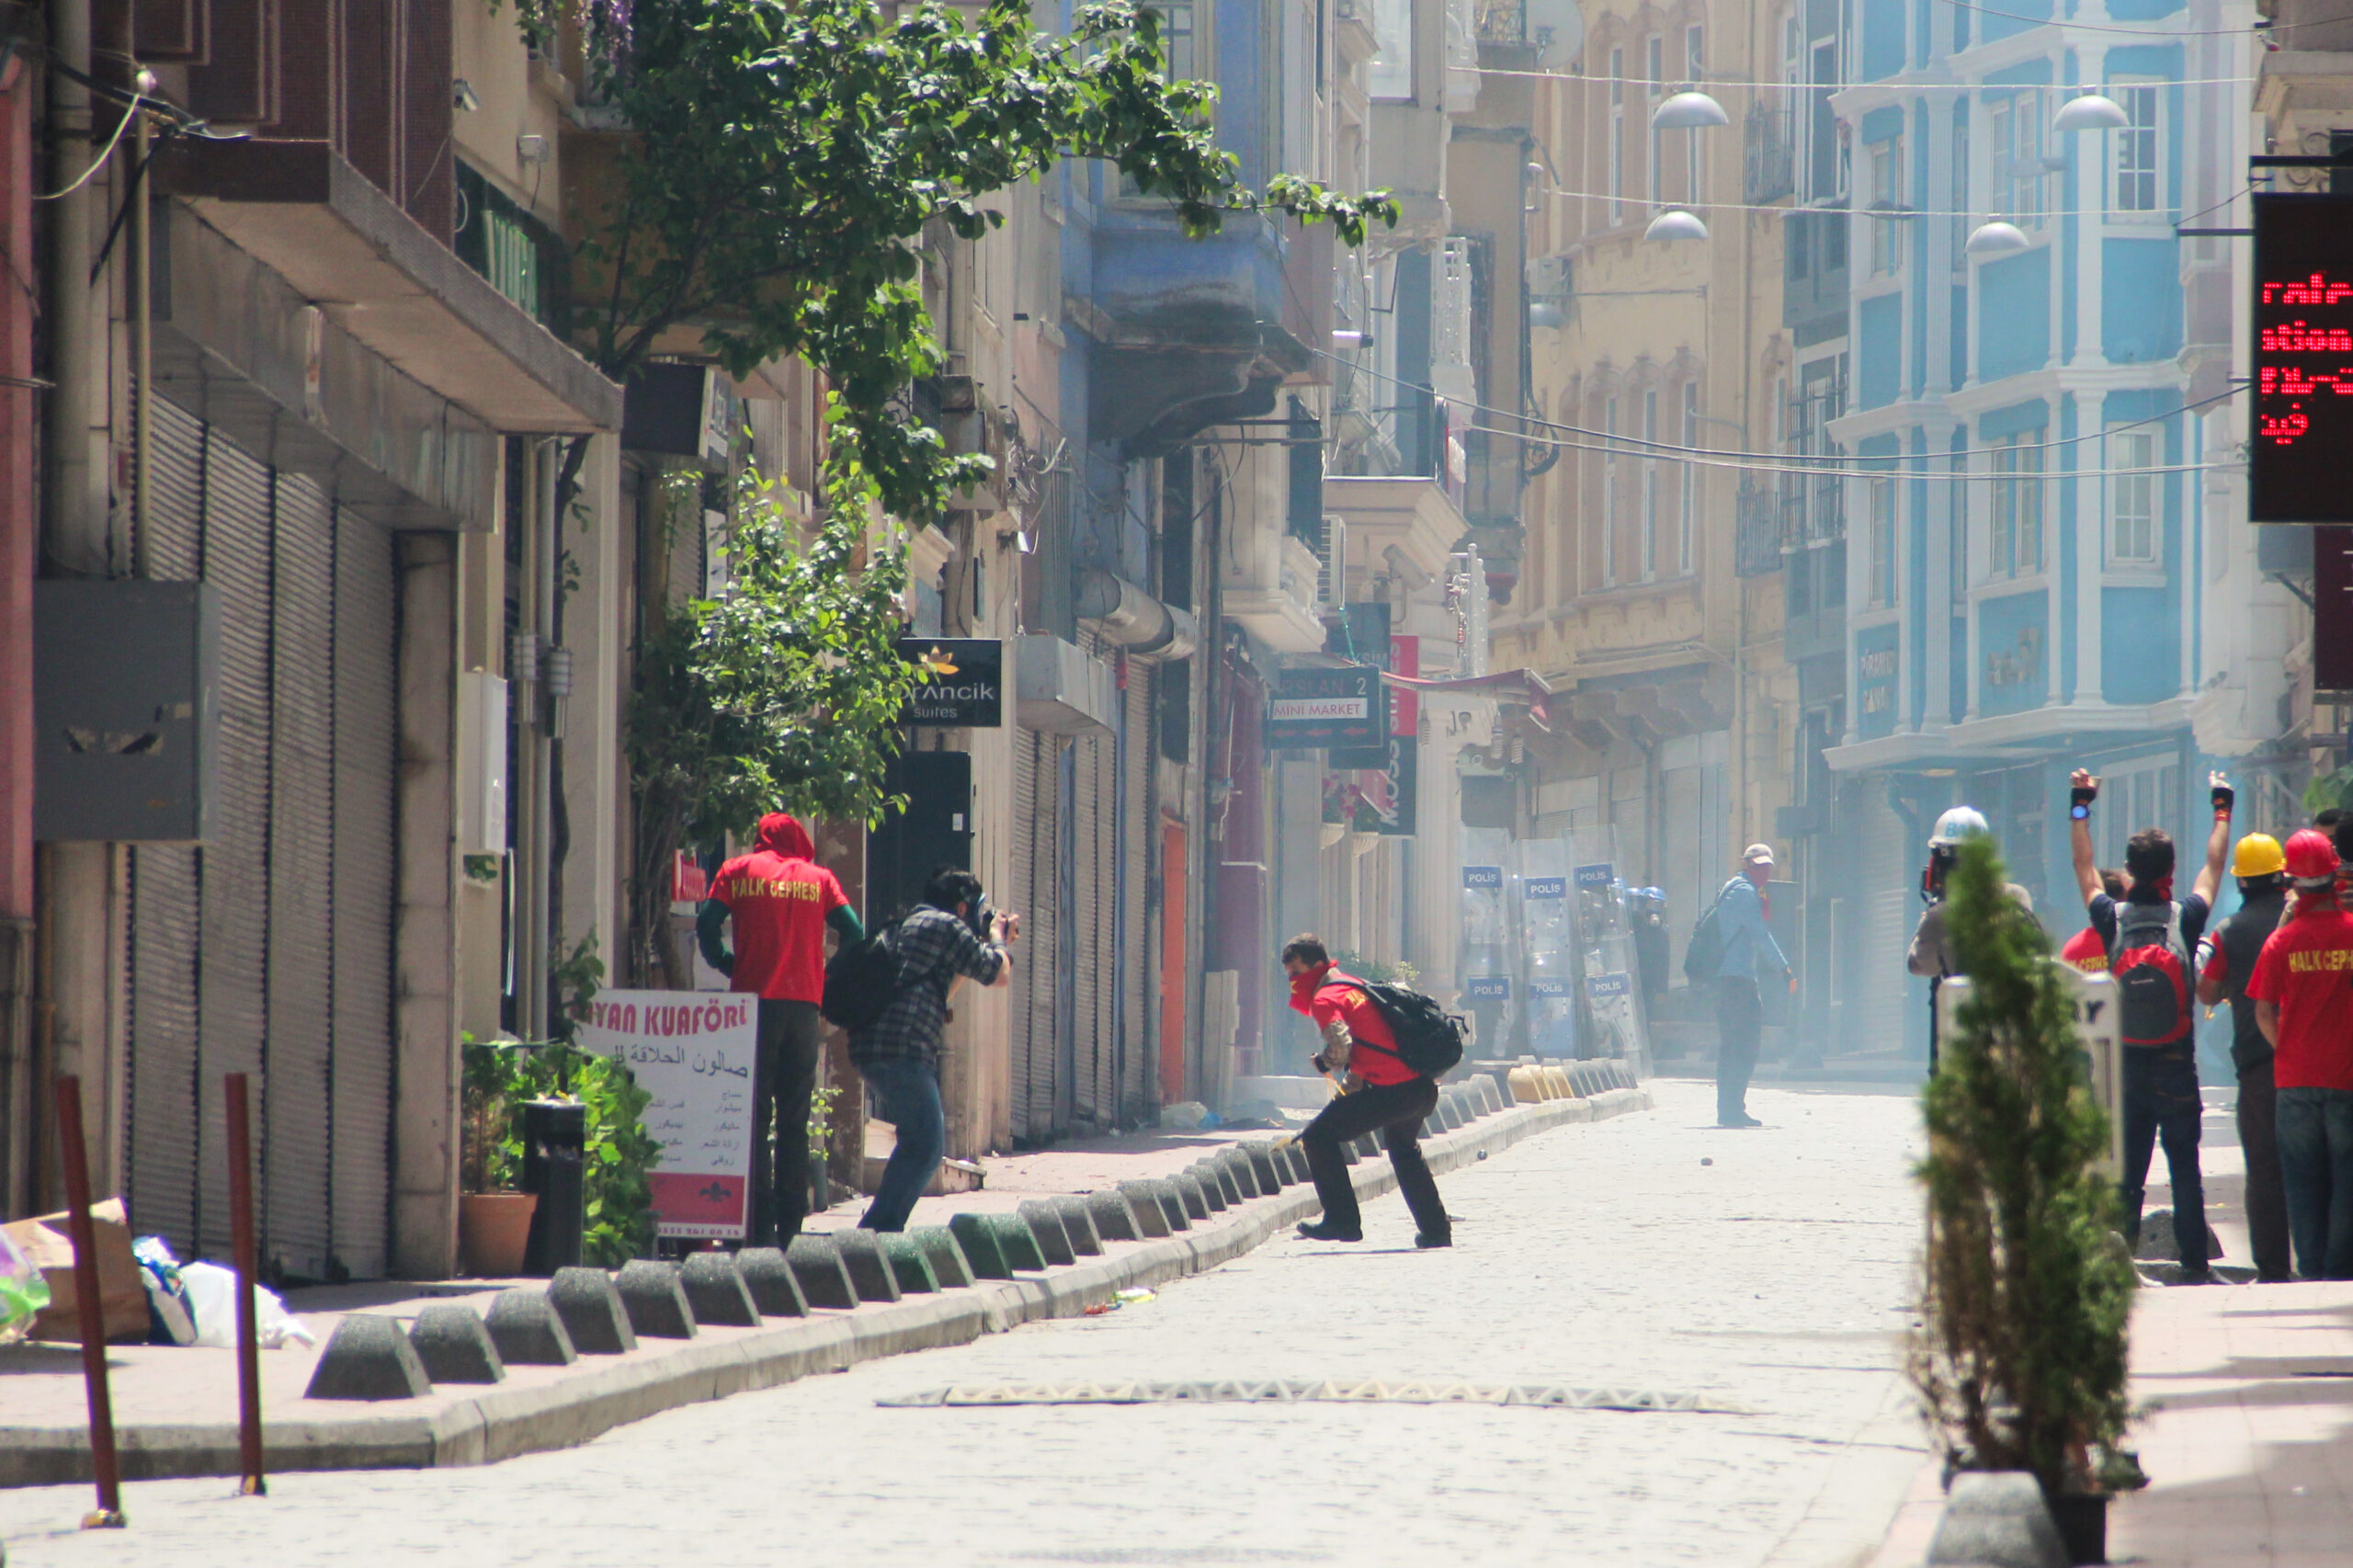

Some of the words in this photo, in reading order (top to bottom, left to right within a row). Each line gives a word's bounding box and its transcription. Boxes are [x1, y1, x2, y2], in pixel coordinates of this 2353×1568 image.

[1356, 676, 1368, 696] 2
[1309, 703, 1361, 716] MARKET
[732, 879, 765, 900] HALK
[692, 1050, 748, 1079] صالون
